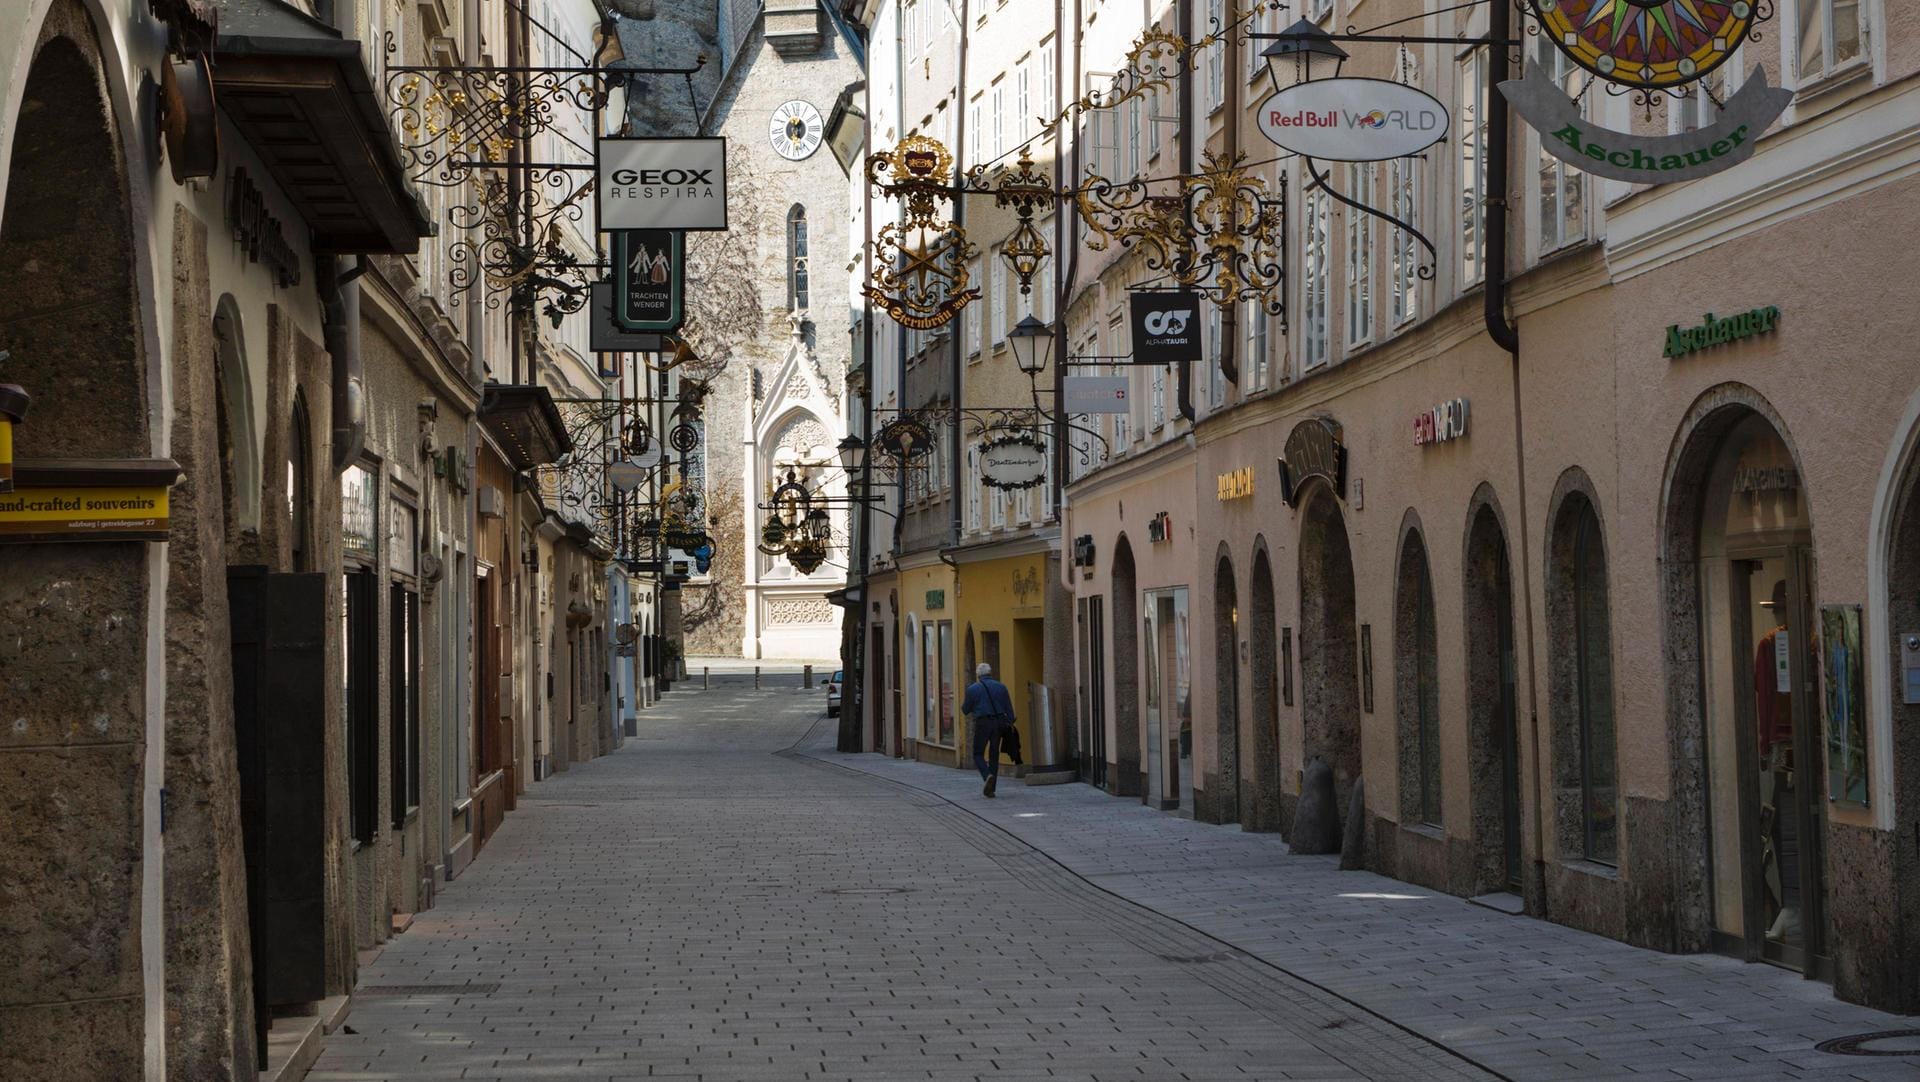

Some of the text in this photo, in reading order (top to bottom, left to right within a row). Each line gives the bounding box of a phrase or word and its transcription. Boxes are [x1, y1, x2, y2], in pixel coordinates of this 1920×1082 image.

[1270, 111, 1303, 127] Red
[1306, 111, 1337, 127] Bull
[1551, 123, 1749, 171] Aschauer
[612, 169, 713, 185] GEOX
[612, 188, 714, 198] RESPIRA
[630, 292, 669, 300] TRACHTEN
[633, 301, 665, 309] WENGER
[890, 306, 953, 329] Sternbräu
[1663, 304, 1781, 358] Aschauer
[86, 496, 155, 510] souvenirs
